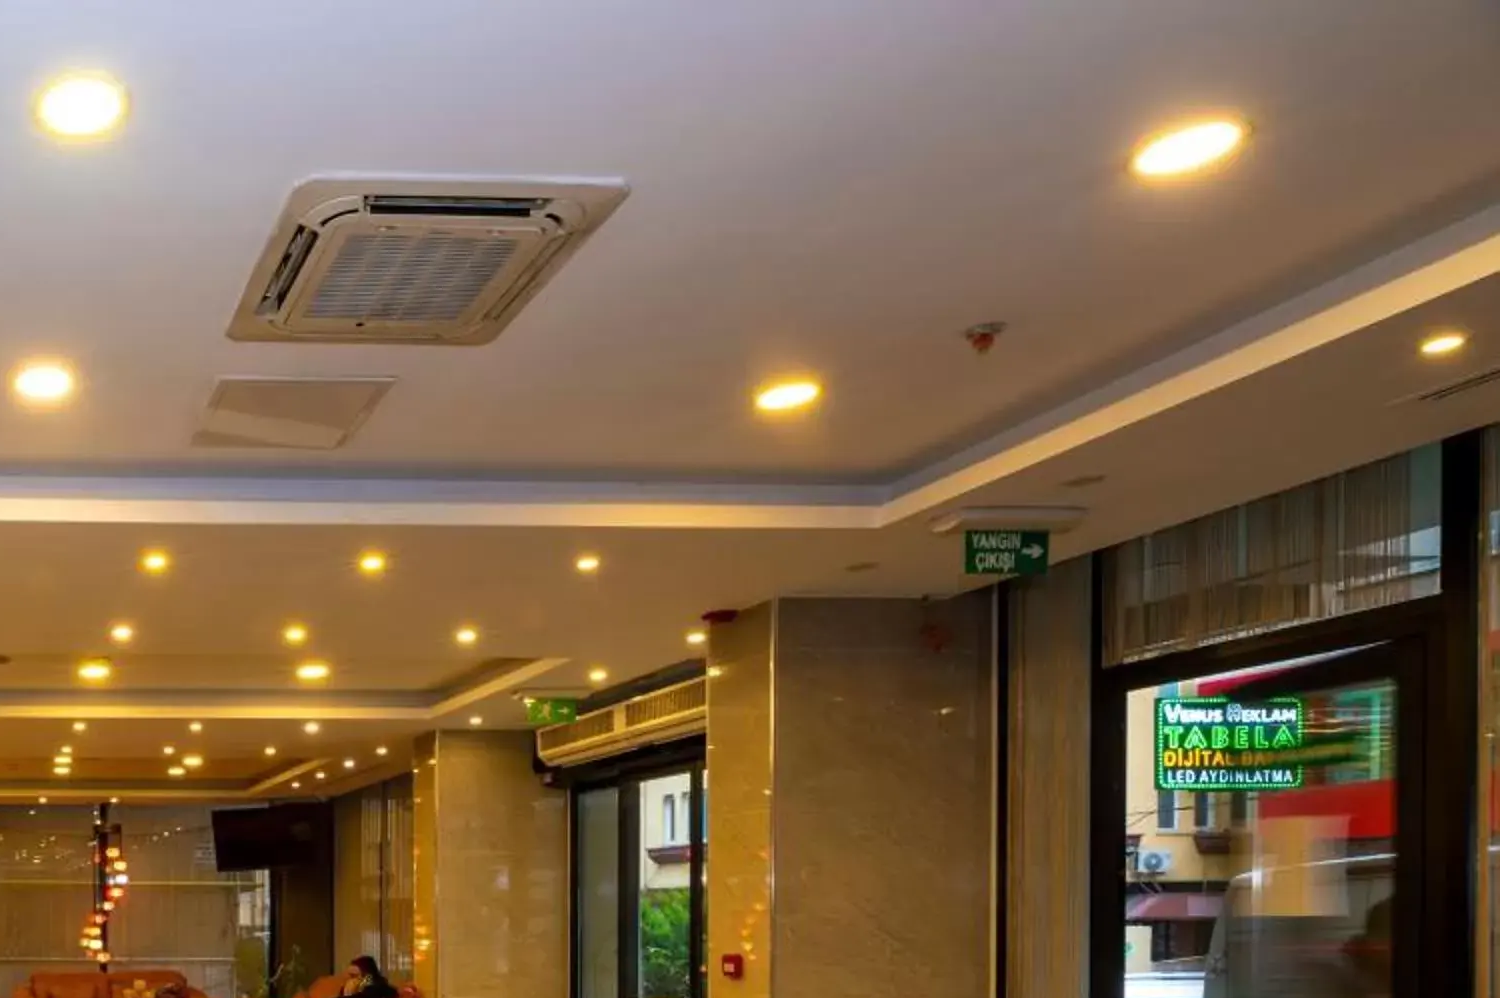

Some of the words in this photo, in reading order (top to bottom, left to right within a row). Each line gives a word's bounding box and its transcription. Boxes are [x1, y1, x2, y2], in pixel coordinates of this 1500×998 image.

[971, 532, 1021, 550] YANGIN
[1163, 724, 1297, 749] TABELA
[1167, 769, 1197, 783] LED
[1199, 769, 1294, 783] AYDINLATMA
